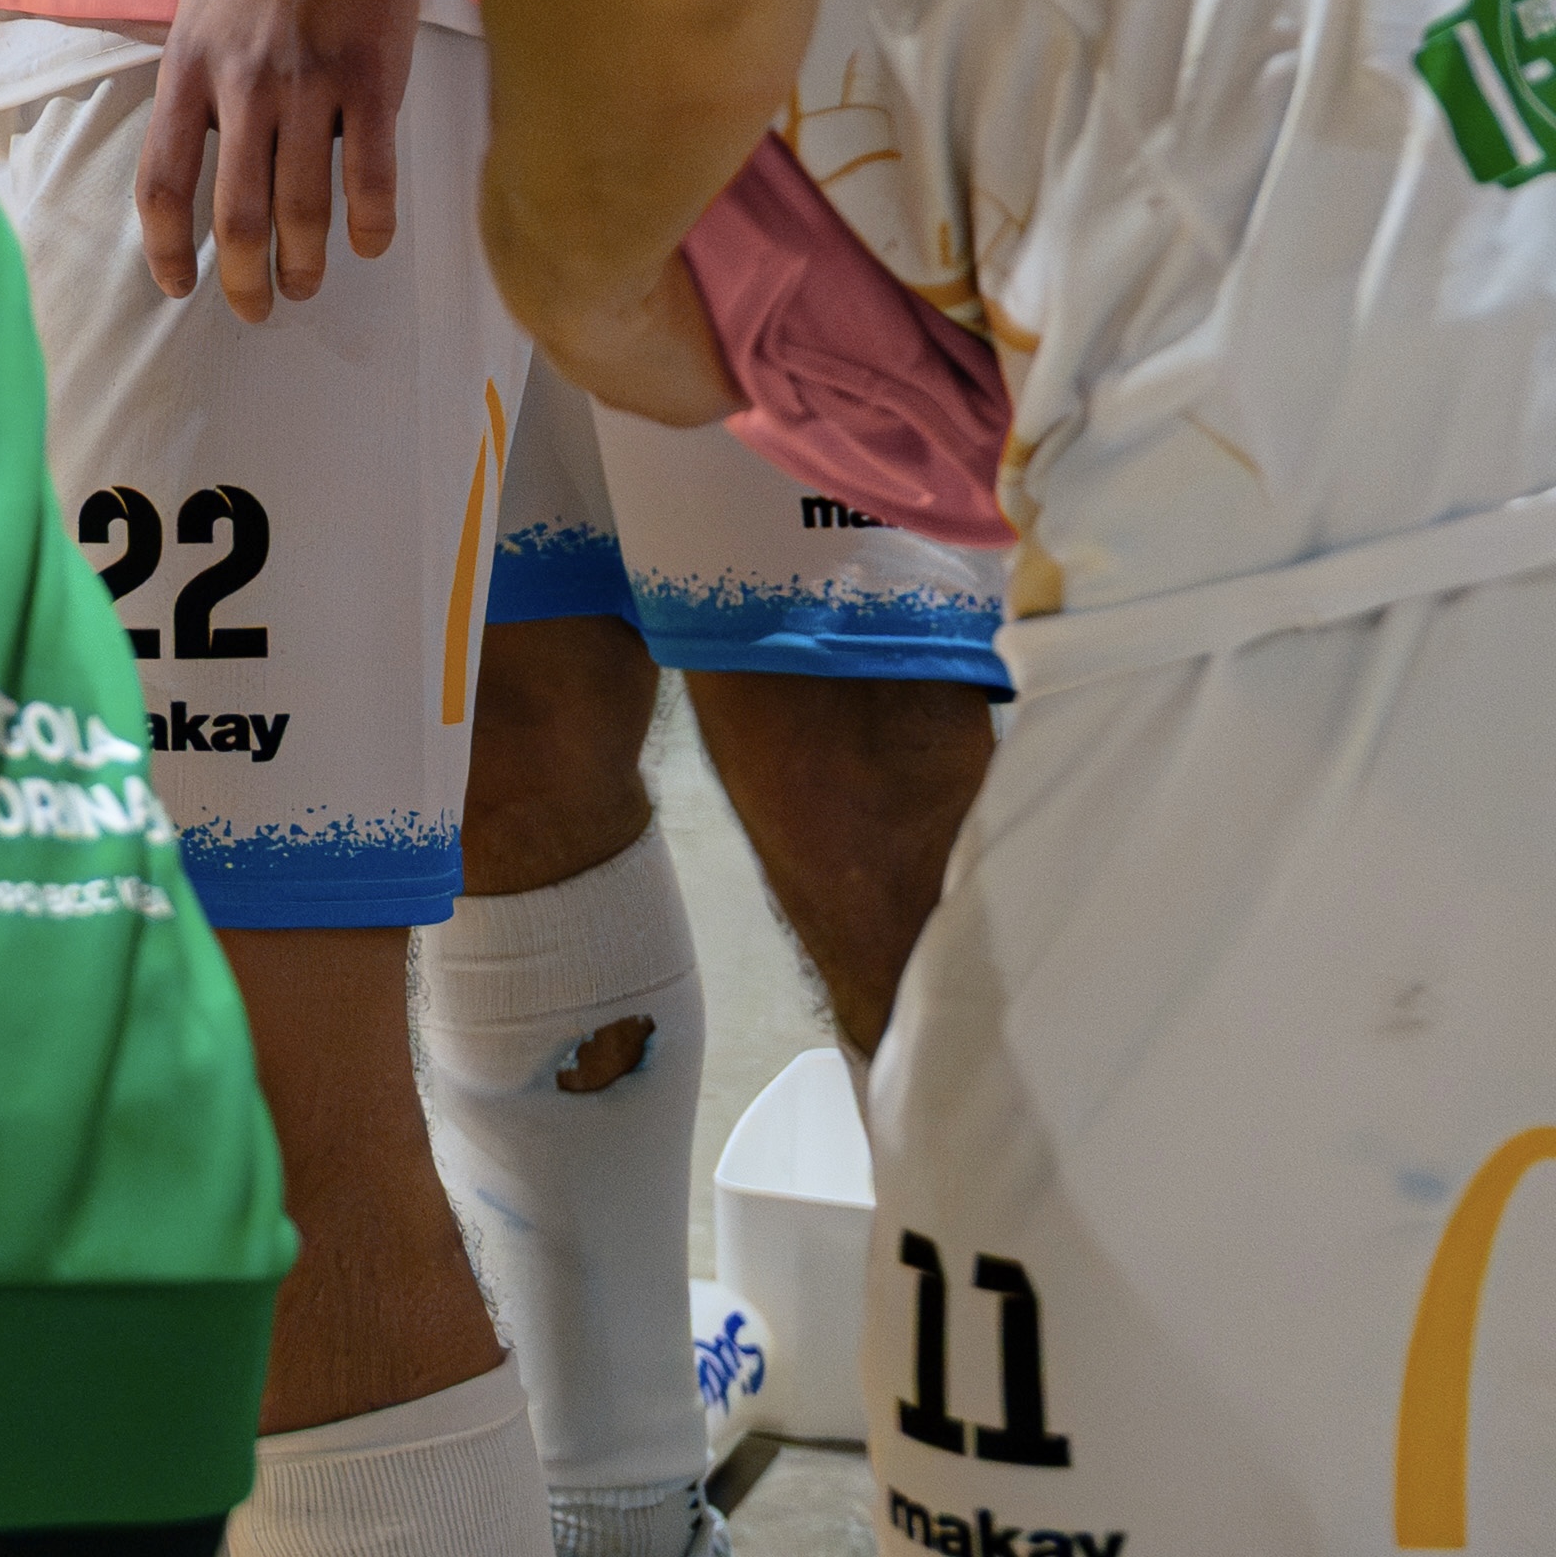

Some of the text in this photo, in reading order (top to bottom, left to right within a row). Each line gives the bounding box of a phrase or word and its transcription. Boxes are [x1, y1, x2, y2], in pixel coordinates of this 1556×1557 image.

[78, 484, 270, 660] 22
[147, 700, 290, 763] akay
[895, 1228, 1072, 1468] 11
